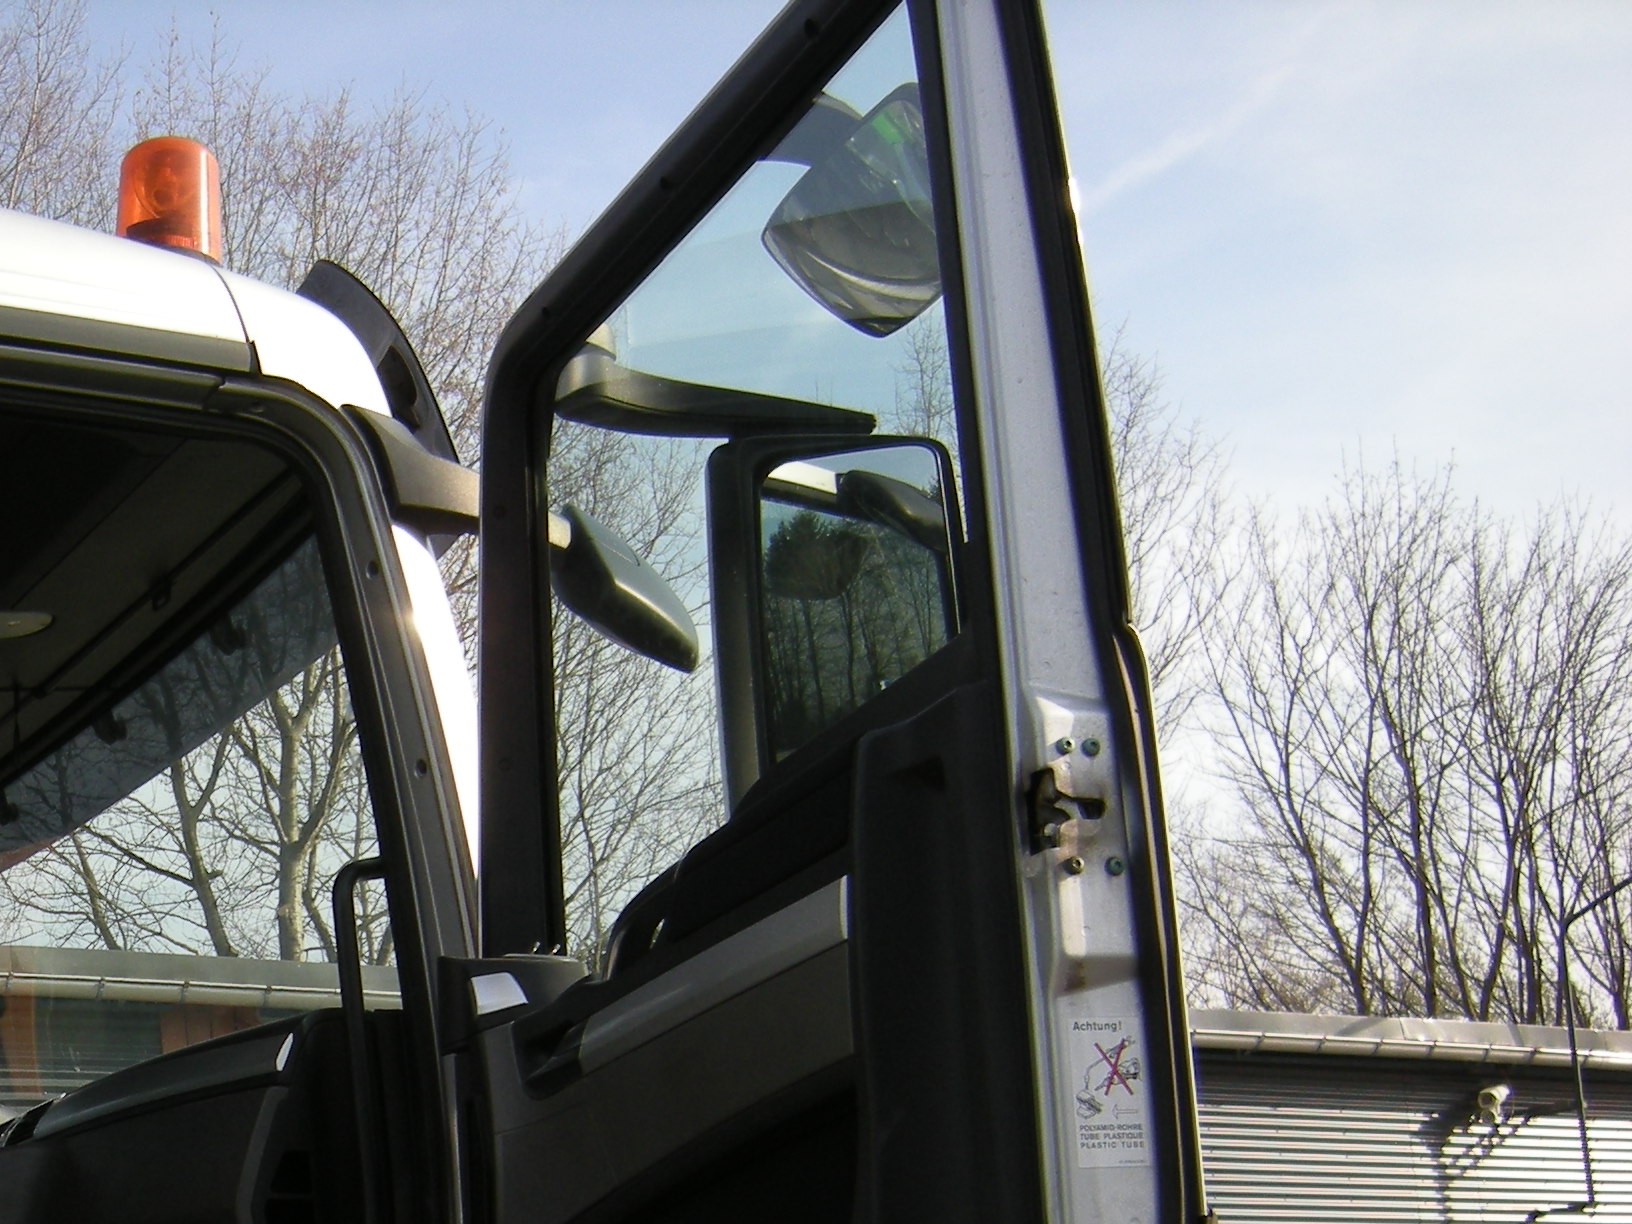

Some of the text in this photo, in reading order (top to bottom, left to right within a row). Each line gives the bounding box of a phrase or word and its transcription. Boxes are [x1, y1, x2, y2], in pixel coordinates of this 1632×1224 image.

[1072, 1021, 1122, 1032] Achtung!
[1103, 1132, 1144, 1140] PLASTIQUE
[1080, 1140, 1145, 1149] PLASTIC TUBE
